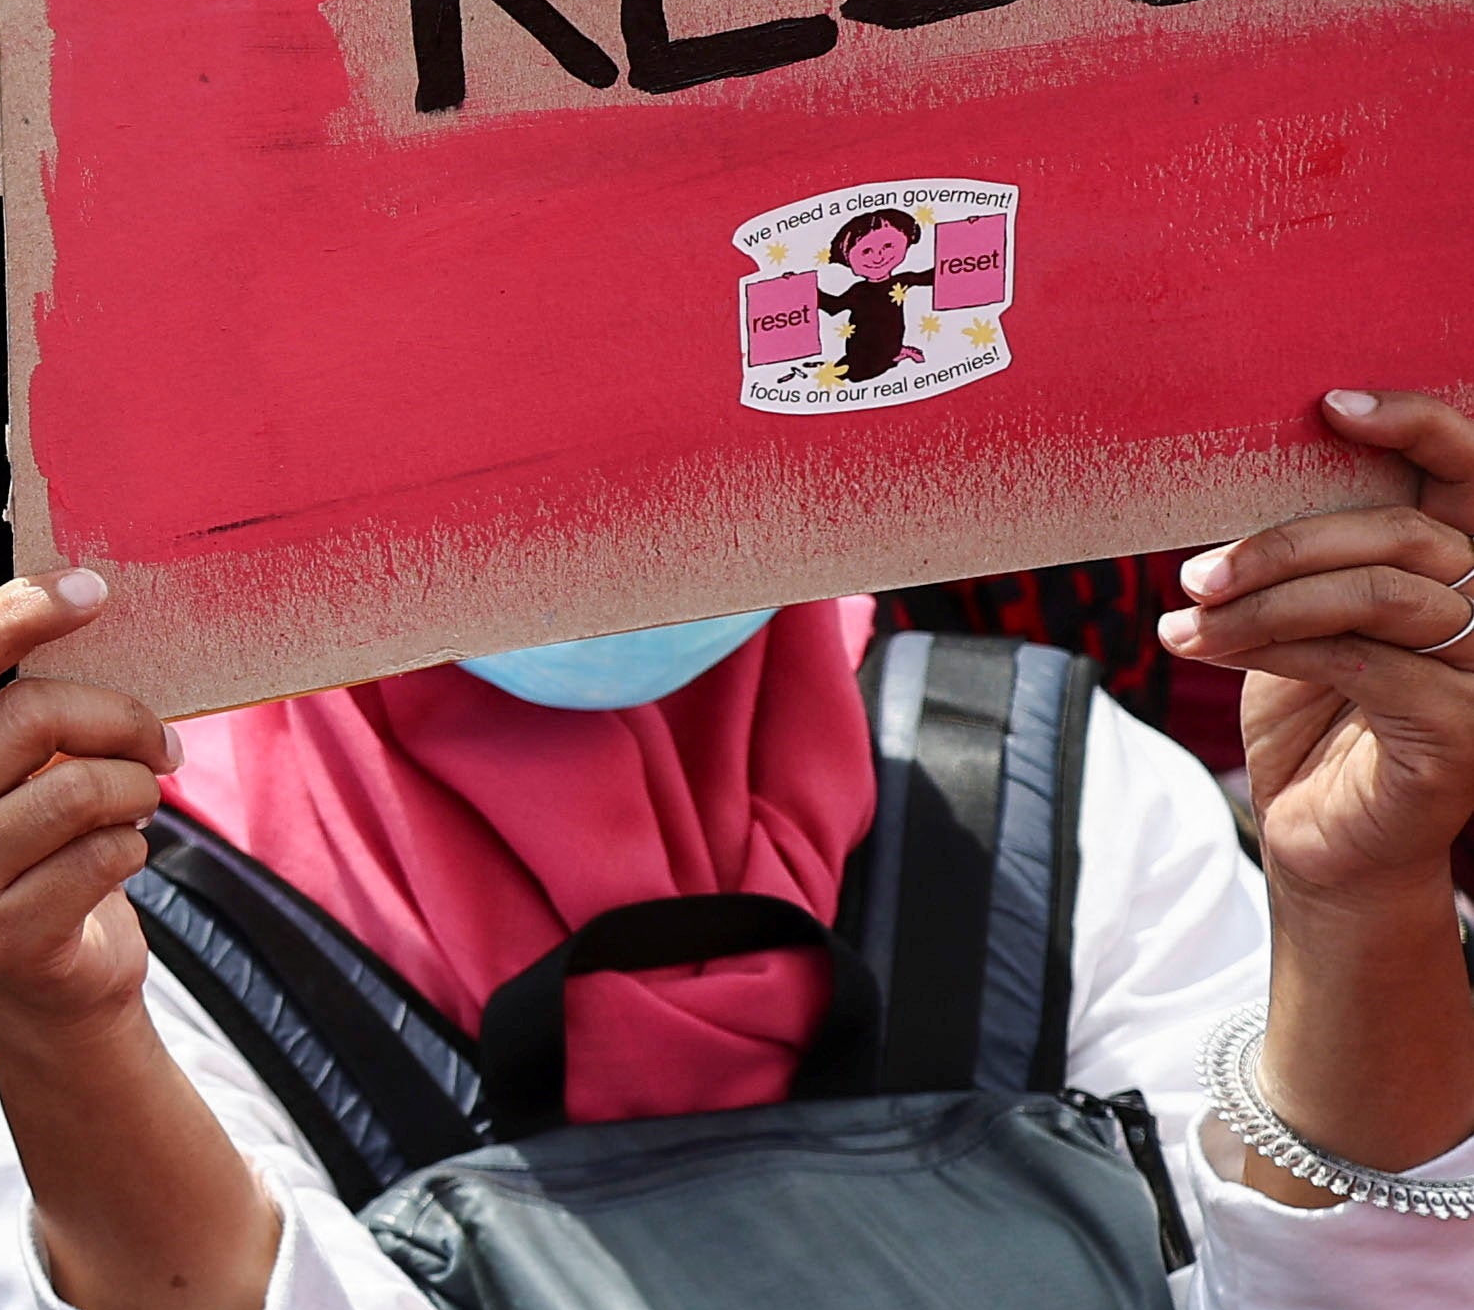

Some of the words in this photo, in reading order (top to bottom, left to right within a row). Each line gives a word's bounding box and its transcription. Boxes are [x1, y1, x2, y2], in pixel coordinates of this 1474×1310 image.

[743, 225, 773, 248] we
[776, 204, 824, 234] need
[828, 202, 841, 217] a
[846, 189, 898, 212] clean
[902, 188, 1014, 209] goverment!
[939, 250, 1001, 276] reset
[751, 305, 812, 333] reset
[749, 381, 802, 404] focus
[806, 390, 830, 403] on
[836, 386, 869, 402] our
[872, 375, 909, 399] real
[912, 345, 1001, 392] enemies!
